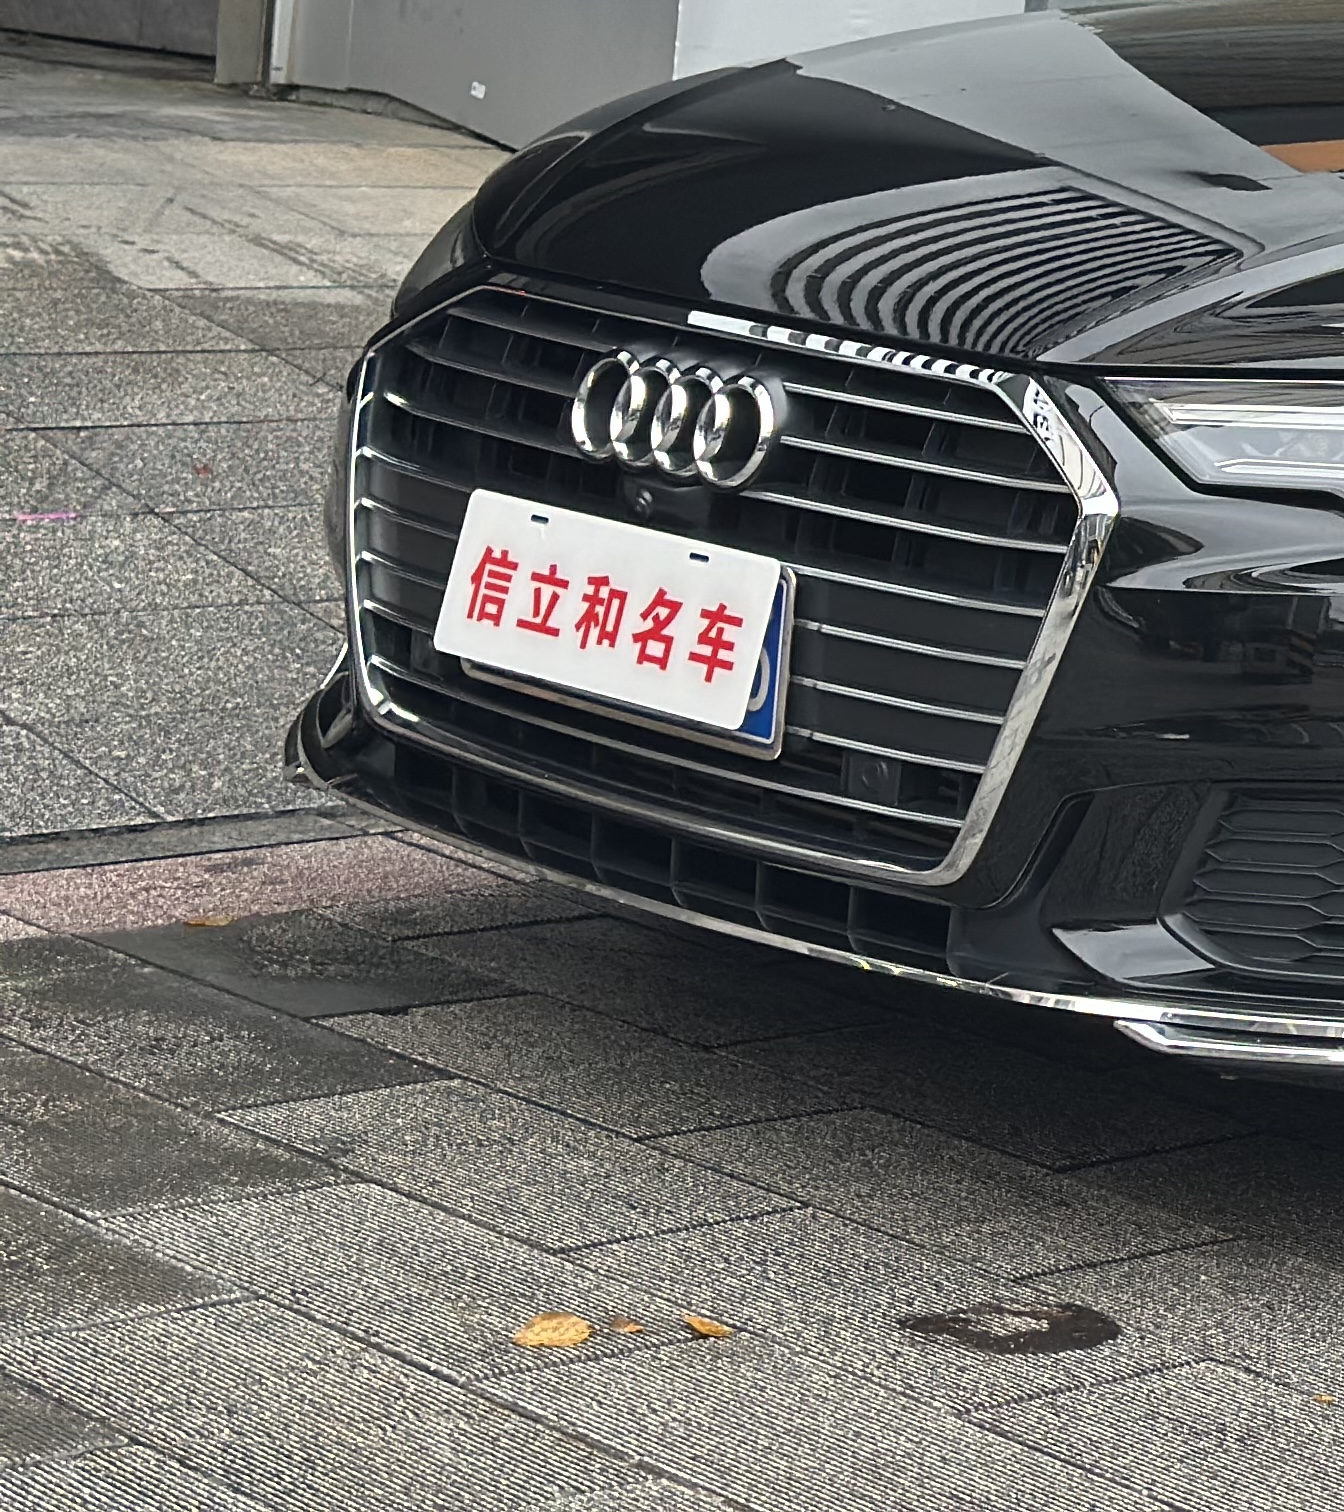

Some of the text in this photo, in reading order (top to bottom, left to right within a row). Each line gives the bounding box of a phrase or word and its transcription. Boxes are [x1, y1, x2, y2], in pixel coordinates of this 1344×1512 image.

[466, 546, 744, 683] 信立和名车
